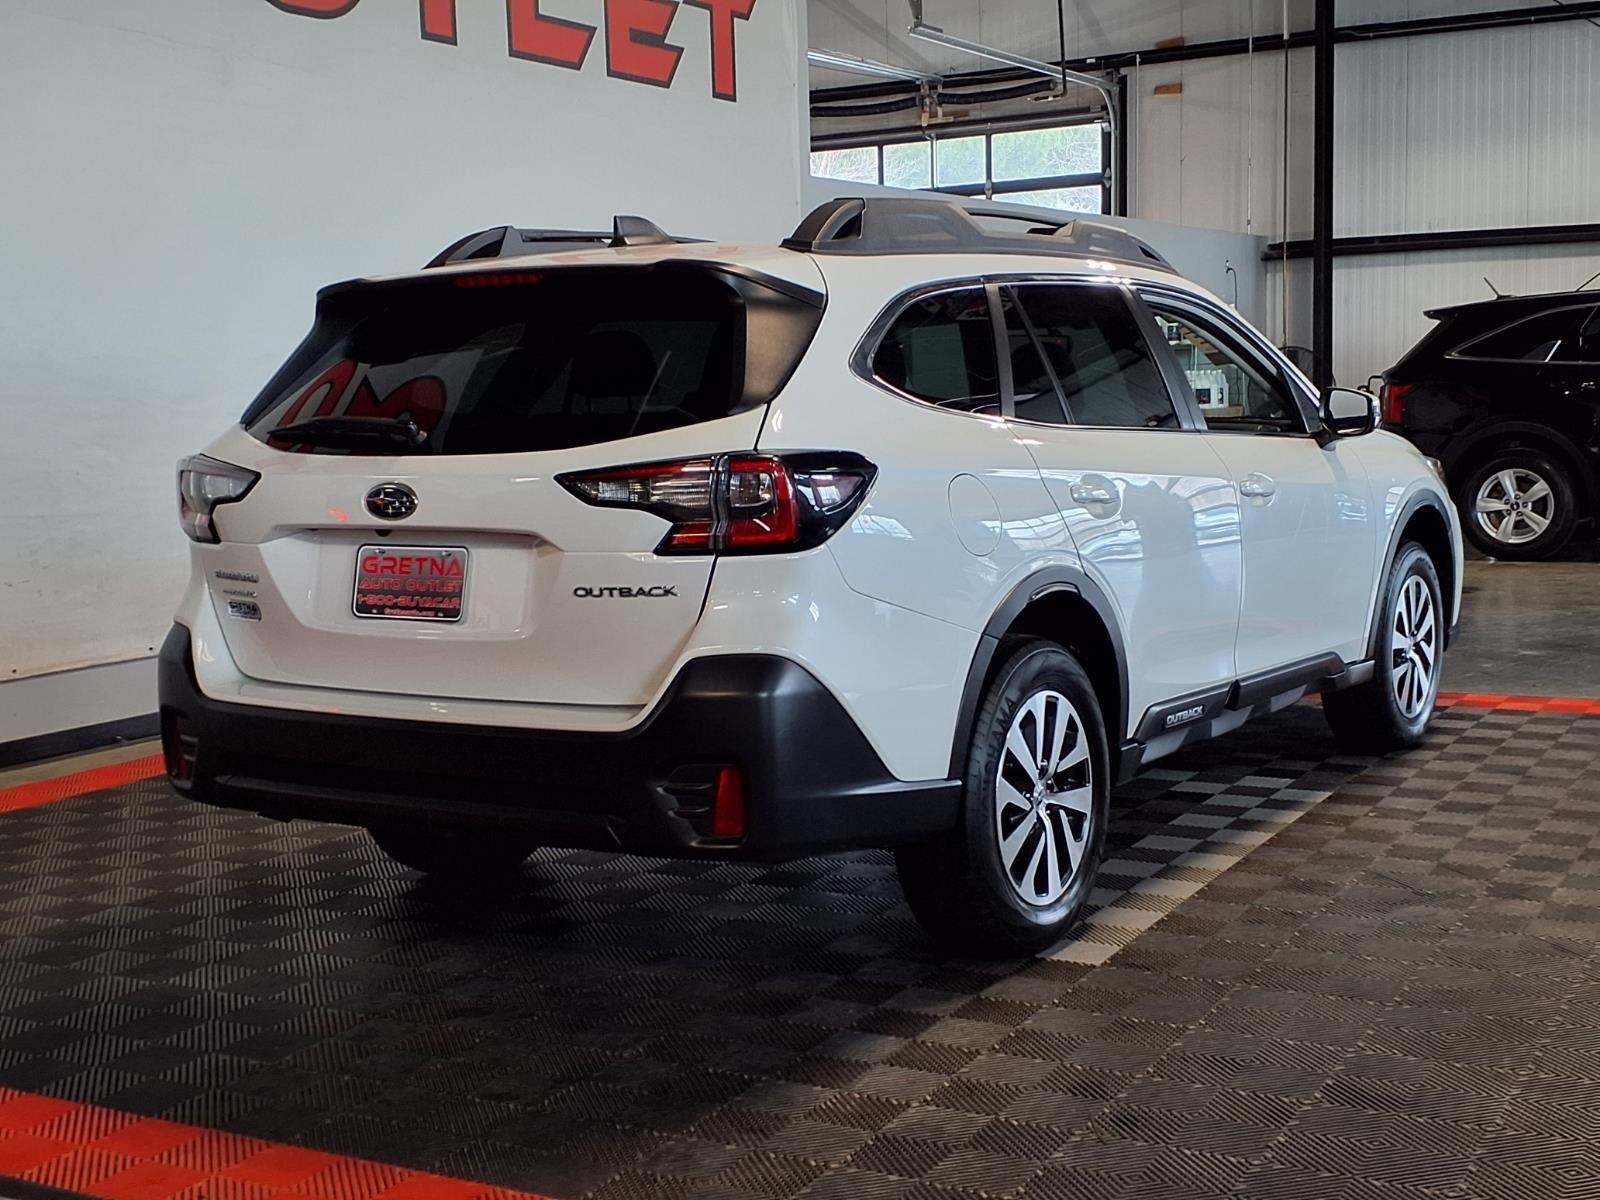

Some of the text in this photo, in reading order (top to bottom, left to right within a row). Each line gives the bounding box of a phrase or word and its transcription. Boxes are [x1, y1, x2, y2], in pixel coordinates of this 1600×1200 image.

[362, 555, 463, 577] GRETNA
[359, 577, 463, 592] AUTO OUTLET
[573, 585, 679, 598] OUTBACK
[1166, 705, 1204, 725] OUTBACK
